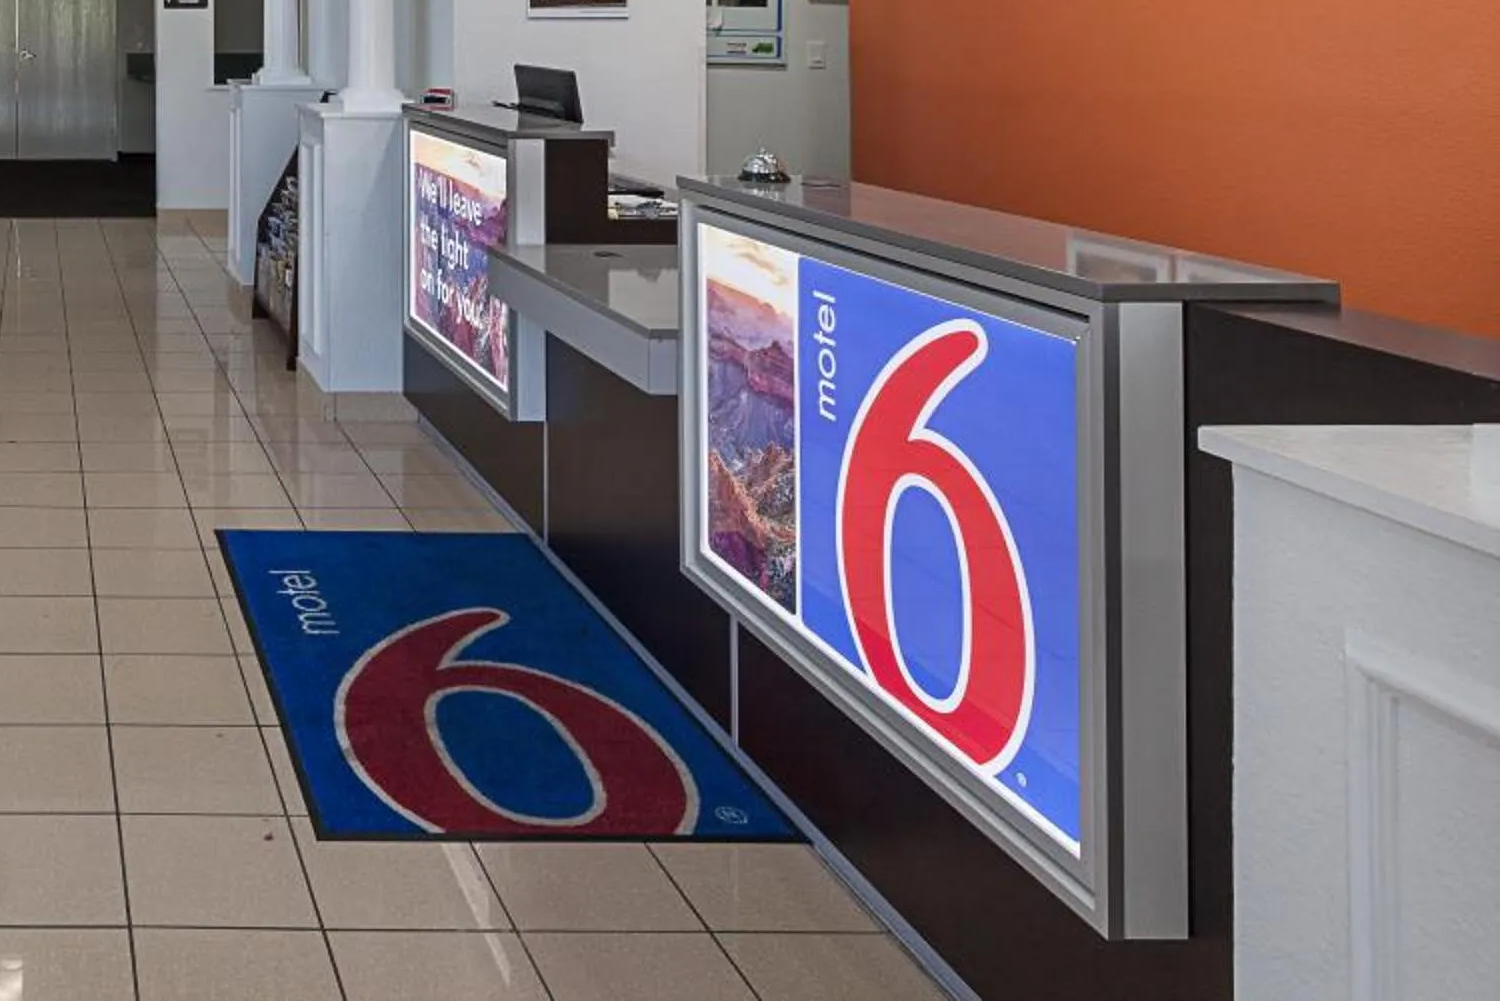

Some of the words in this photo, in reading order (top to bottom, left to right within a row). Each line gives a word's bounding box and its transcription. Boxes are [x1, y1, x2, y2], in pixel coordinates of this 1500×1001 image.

[449, 178, 482, 226] leave
[419, 216, 439, 251] the
[440, 223, 469, 270] light
[419, 267, 435, 296] on
[437, 268, 455, 305] for
[812, 289, 837, 422] motel
[835, 317, 1036, 778] 6
[267, 569, 341, 635] motel
[333, 606, 700, 836] 6
